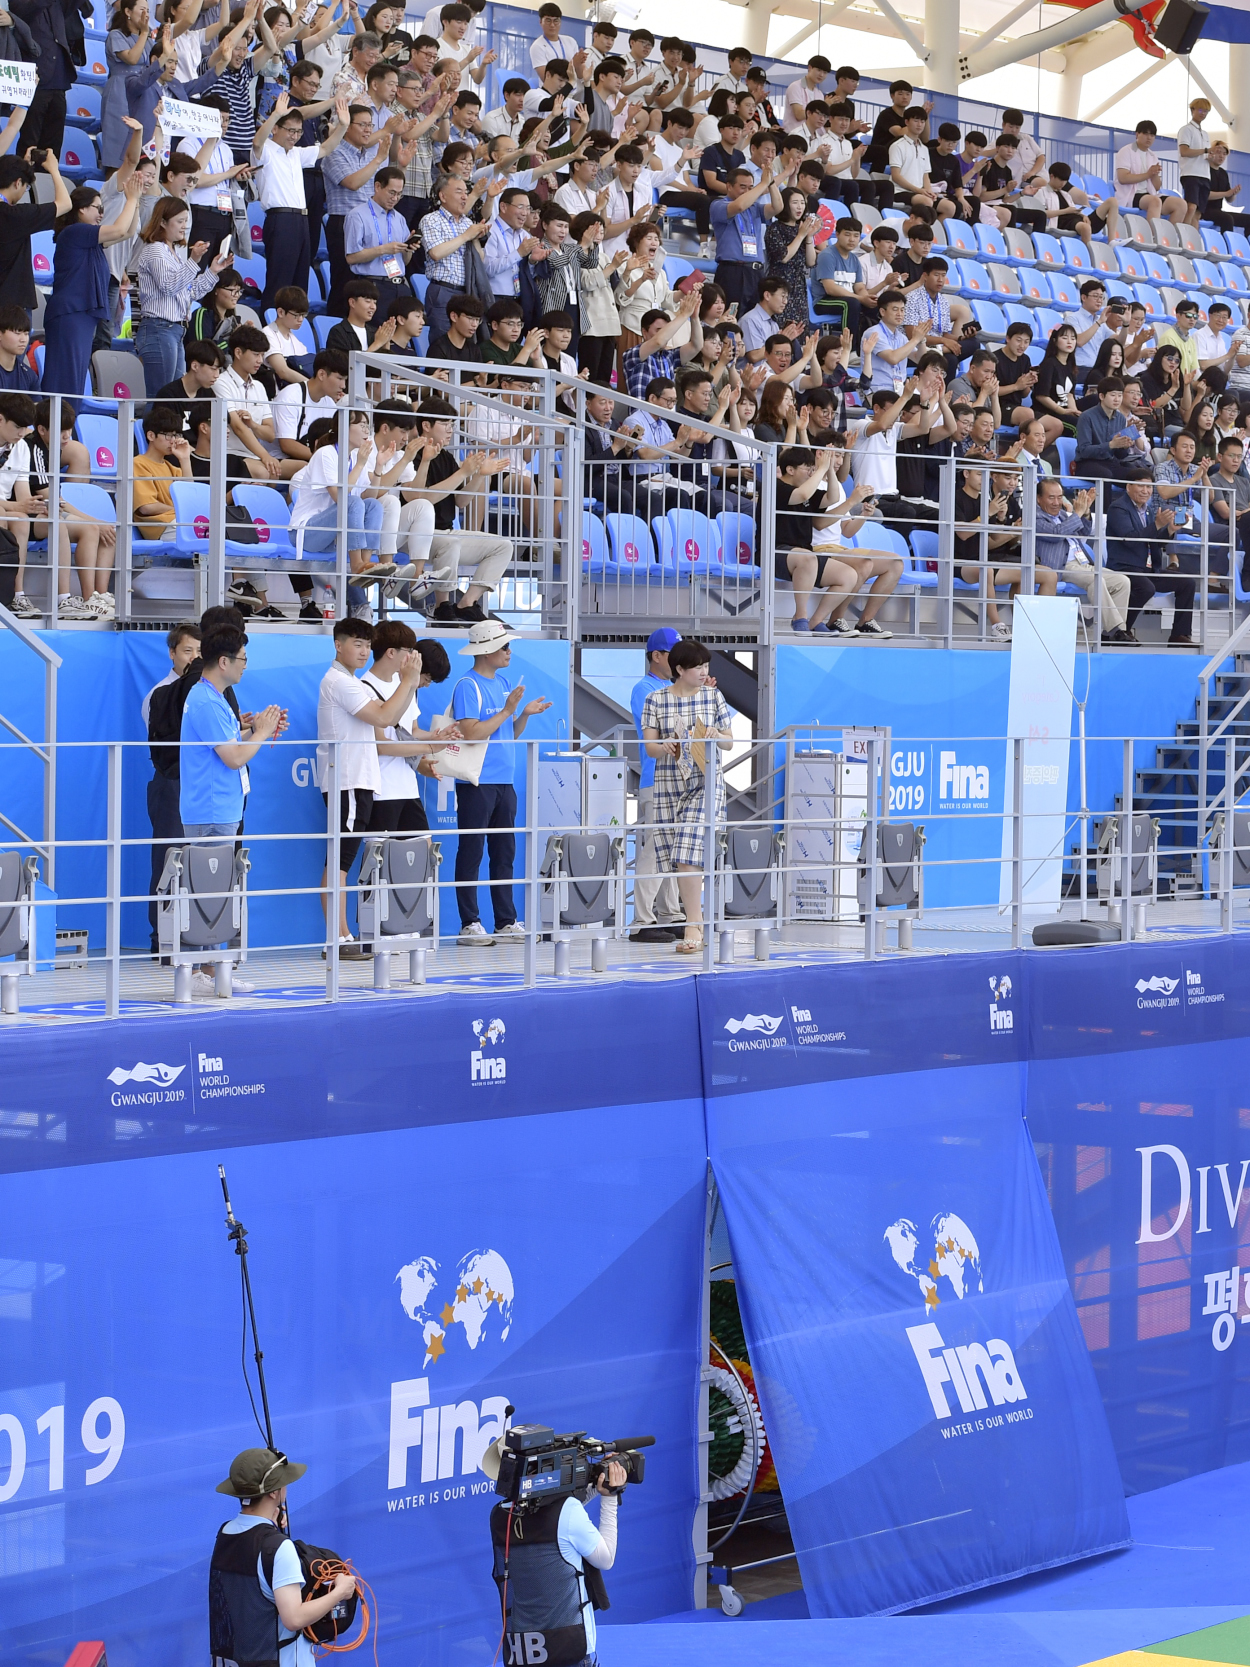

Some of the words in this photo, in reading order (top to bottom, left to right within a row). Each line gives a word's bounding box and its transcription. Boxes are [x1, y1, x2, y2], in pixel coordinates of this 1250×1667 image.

[81, 604, 109, 615] OSTON
[939, 751, 990, 799] Fina
[889, 785, 924, 810] 2019
[1186, 969, 1201, 985] Fina
[1187, 986, 1204, 996] WORLD
[1188, 993, 1225, 1005] CHAMPIONSHIPS
[1137, 996, 1167, 1009] GWANGJU
[1167, 997, 1180, 1008] 2019
[791, 1005, 811, 1023] Fina
[989, 1003, 1013, 1030] Fina
[796, 1024, 818, 1035] WORLD
[798, 1031, 846, 1045] CHAMPIONSHIPS
[729, 1038, 771, 1053] GWANGJU
[771, 1036, 786, 1049] 2019
[198, 1053, 223, 1073] Fina
[471, 1051, 506, 1080] Fina
[200, 1075, 229, 1087] WORLD
[111, 1091, 163, 1107] GWANGJU
[165, 1089, 185, 1103] 2019
[200, 1083, 266, 1099] CHAMPIONSHIPS
[905, 1322, 1028, 1420] Fina
[941, 1423, 973, 1440] WATER
[975, 1419, 985, 1432] IS
[986, 1414, 1005, 1429] OUR
[1005, 1407, 1034, 1425] WORLD
[388, 1377, 513, 1490] Fina
[522, 1479, 533, 1491] HB
[387, 1492, 425, 1513] WATER
[429, 1490, 439, 1504] IS
[443, 1486, 466, 1502] OUR
[471, 1480, 495, 1498] WOR
[507, 1631, 549, 1666] HB
